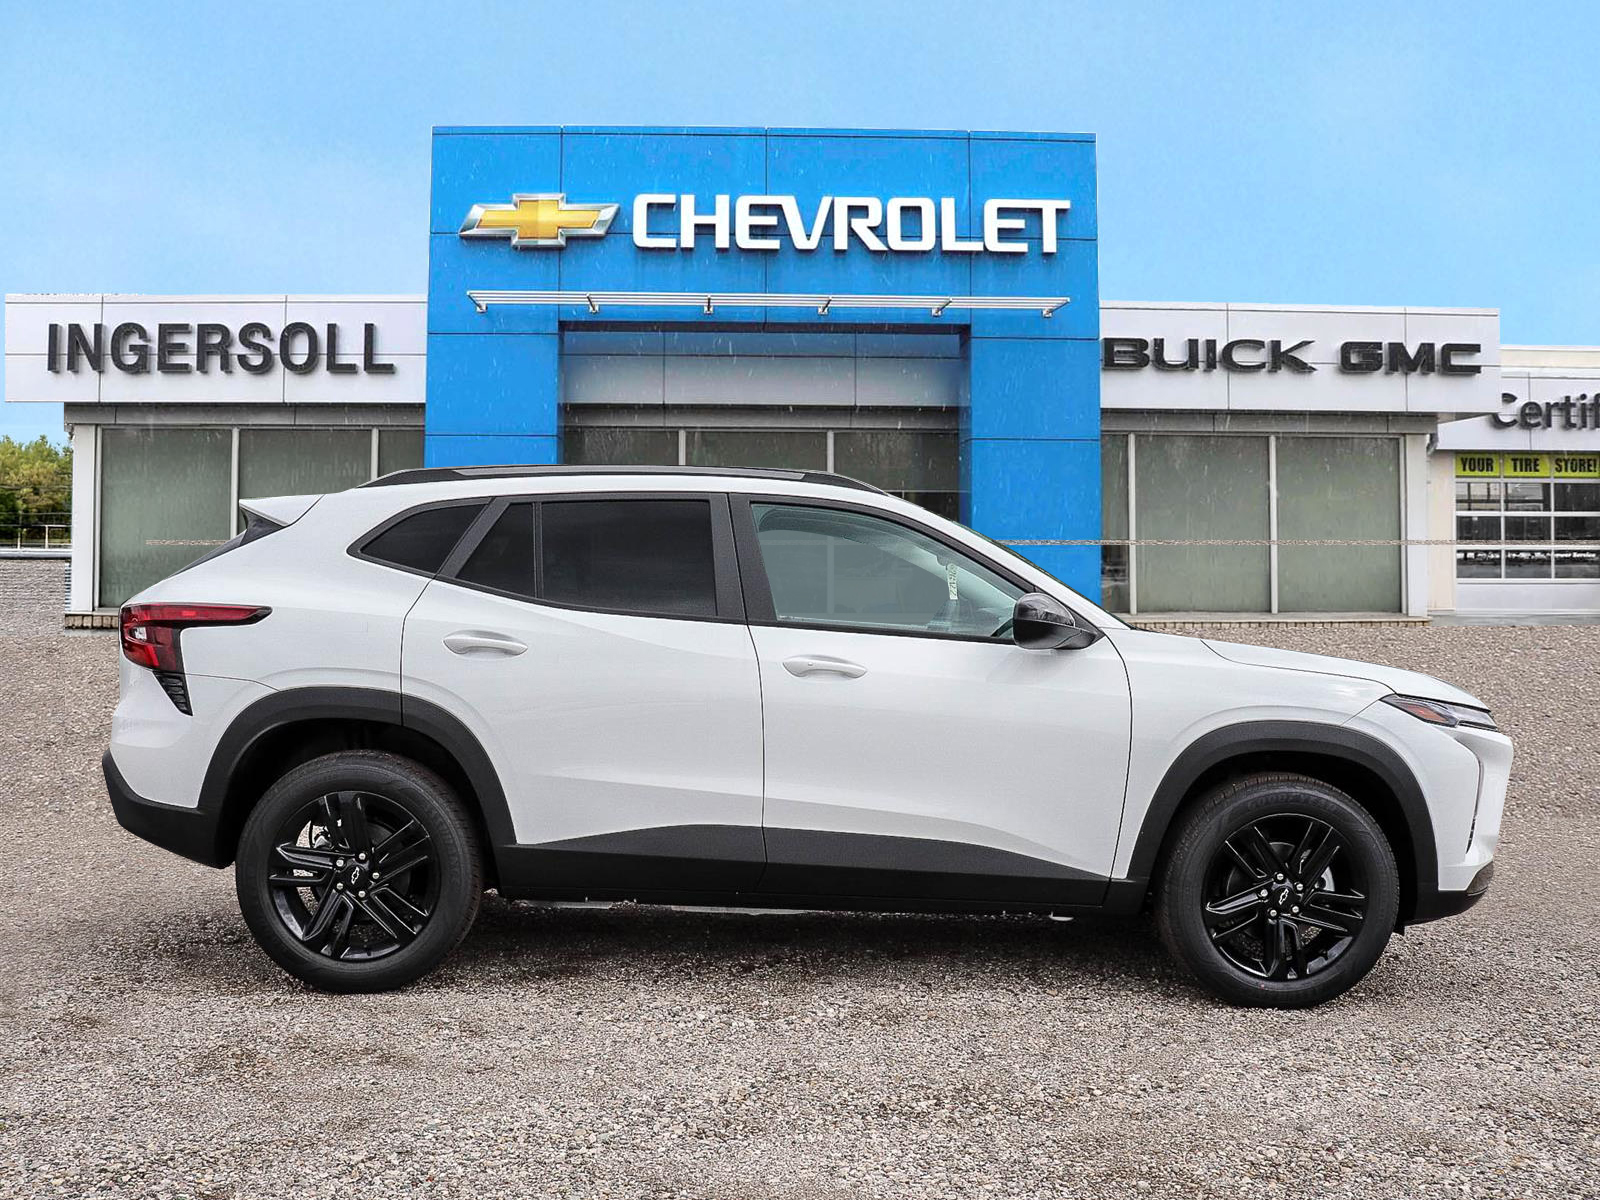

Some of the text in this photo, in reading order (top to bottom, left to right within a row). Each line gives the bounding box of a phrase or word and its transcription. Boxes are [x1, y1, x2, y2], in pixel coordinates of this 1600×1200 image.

[632, 193, 1071, 254] CHEVROLET
[47, 321, 395, 374] INGERSOLL
[1103, 337, 1481, 375] BUICK GMC
[1460, 457, 1597, 472] YOUR TIRE STORE!
